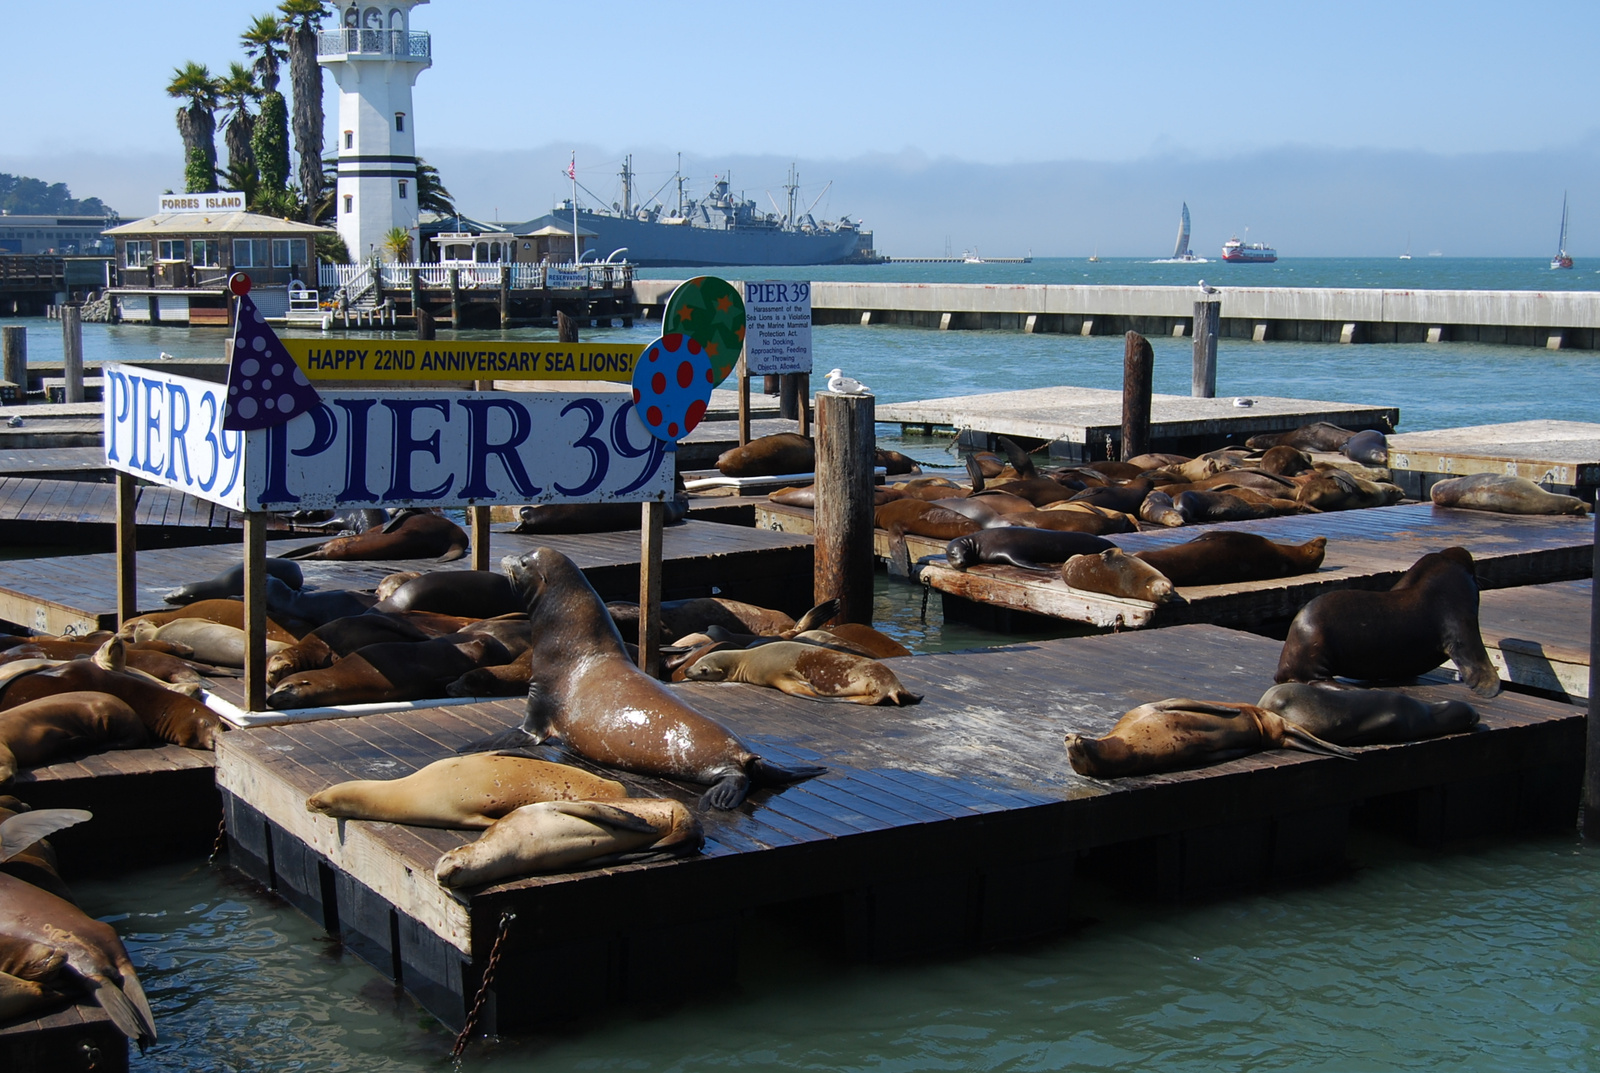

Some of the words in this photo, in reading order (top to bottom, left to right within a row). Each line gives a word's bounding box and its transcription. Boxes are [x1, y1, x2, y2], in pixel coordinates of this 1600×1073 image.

[162, 198, 199, 209] FORBES
[206, 197, 241, 208] ISLAND
[747, 283, 789, 303] PIER
[790, 283, 809, 303] 39
[308, 349, 368, 370] HAPPY
[374, 350, 416, 370] 22ND
[420, 351, 541, 371] ANNIVERSARY
[545, 352, 575, 371] SEA
[580, 353, 633, 372] LIONS!
[108, 370, 194, 486] PIER
[198, 390, 243, 498] 39
[257, 399, 542, 503] PIER
[554, 398, 667, 497] 39
